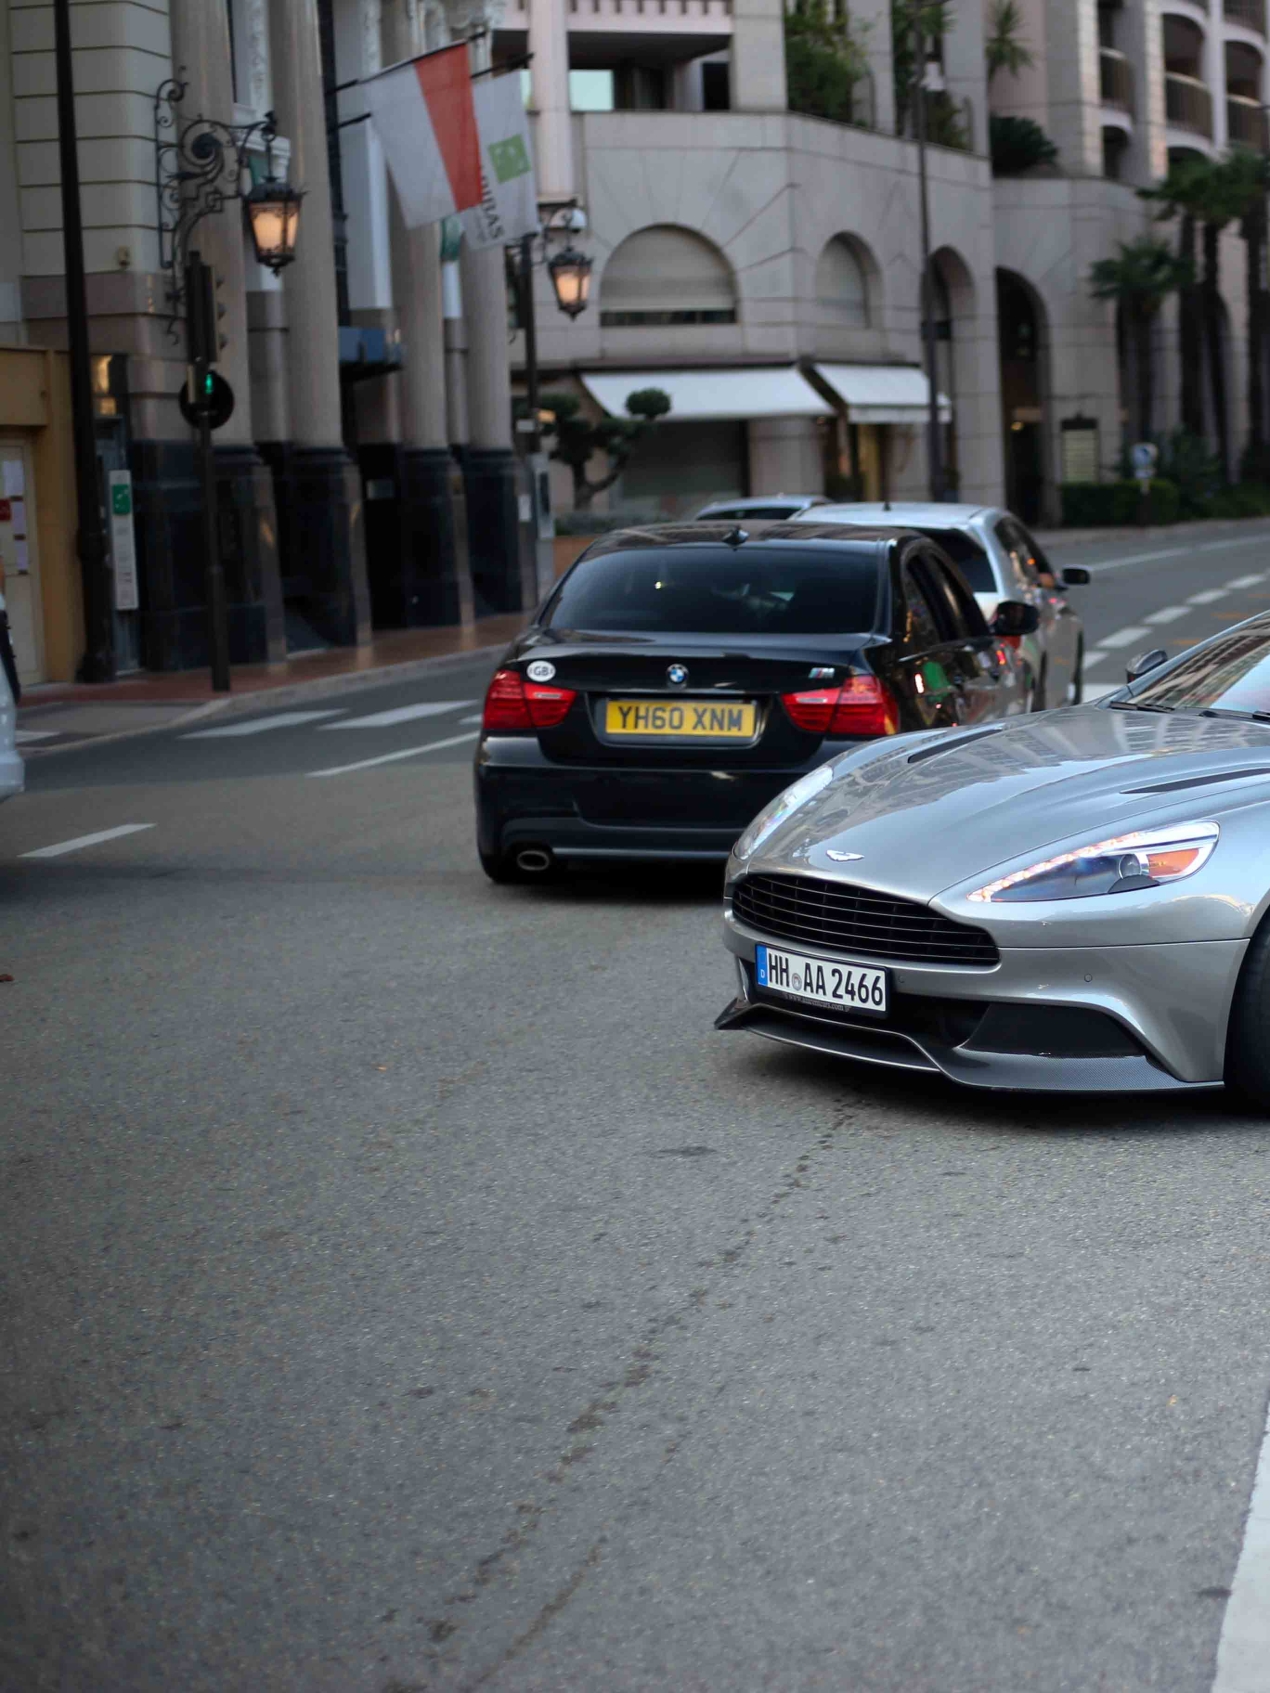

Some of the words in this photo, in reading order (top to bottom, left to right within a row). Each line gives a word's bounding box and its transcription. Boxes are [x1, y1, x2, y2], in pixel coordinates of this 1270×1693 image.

[533, 665, 549, 676] GB
[618, 706, 684, 729] YH60
[692, 707, 743, 732] XNM
[768, 953, 790, 988] HH
[803, 962, 827, 996] AA
[831, 968, 884, 1006] 2466
